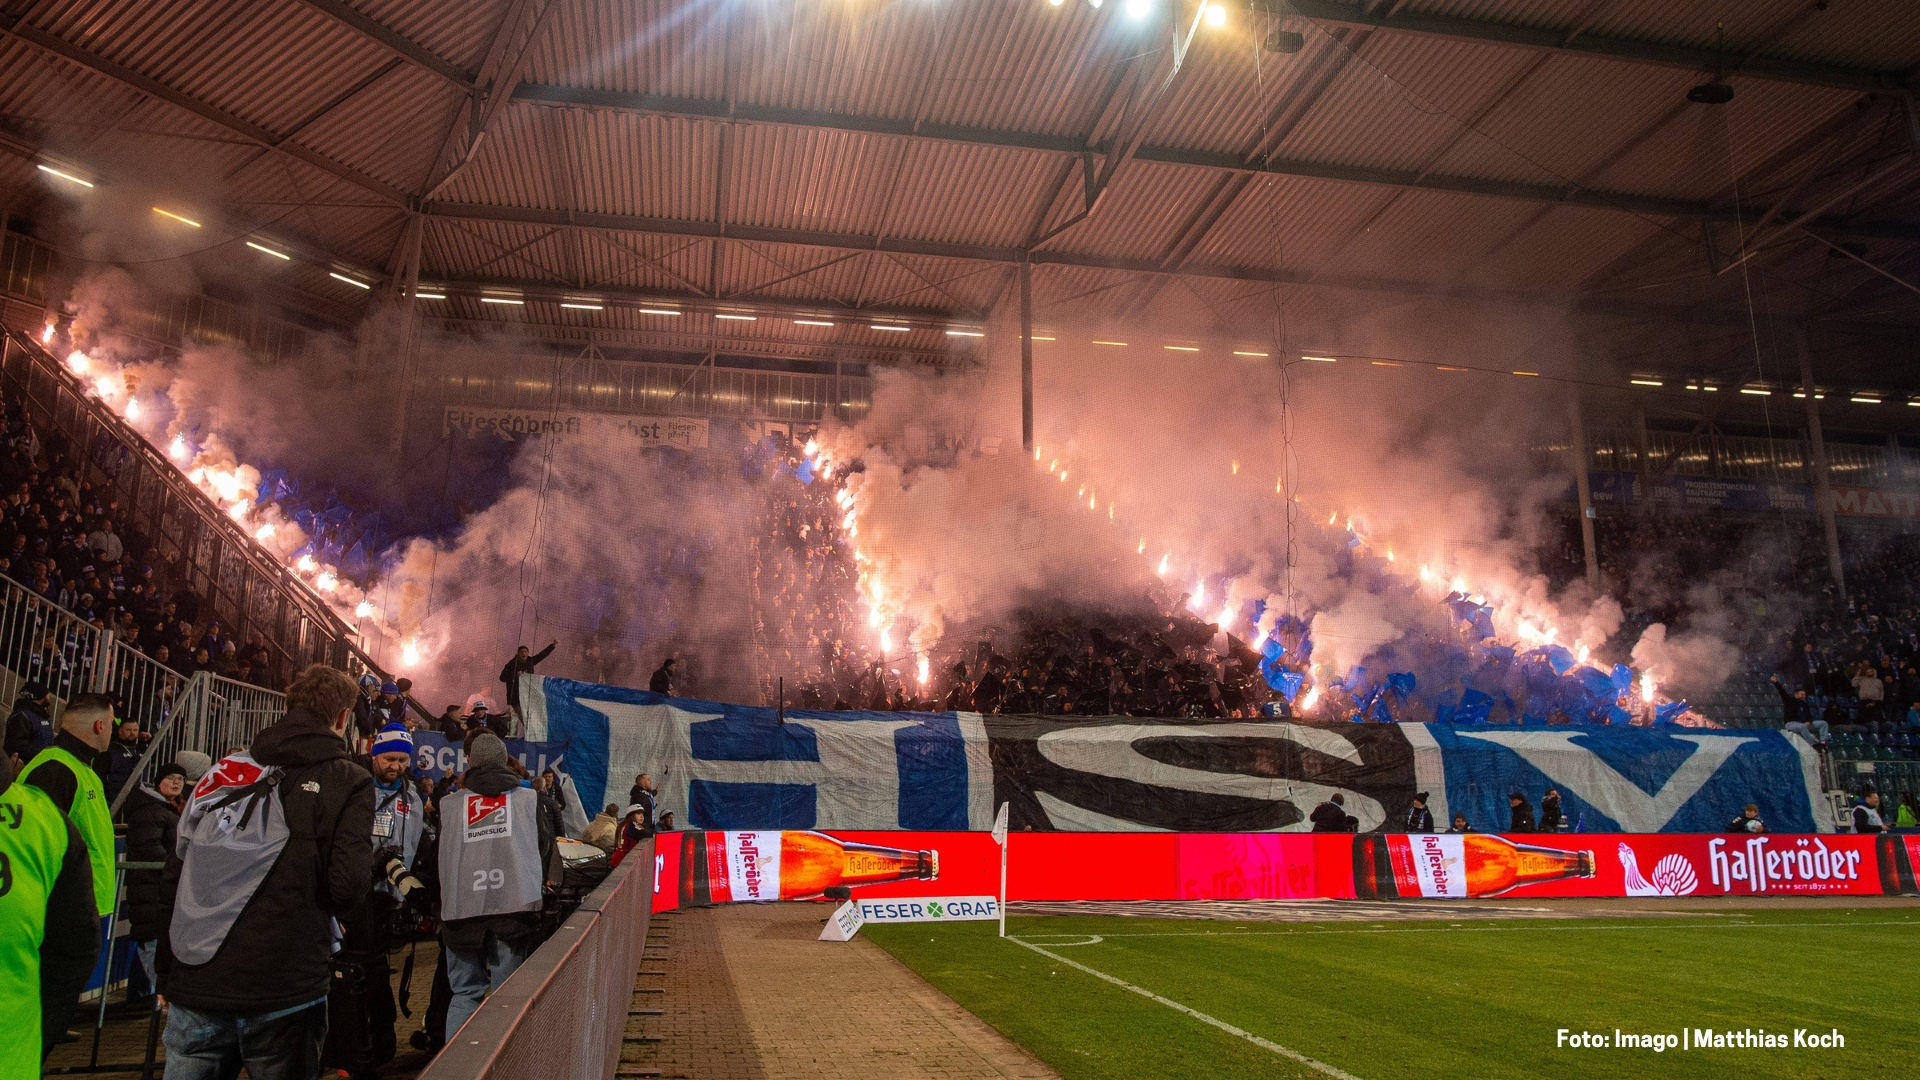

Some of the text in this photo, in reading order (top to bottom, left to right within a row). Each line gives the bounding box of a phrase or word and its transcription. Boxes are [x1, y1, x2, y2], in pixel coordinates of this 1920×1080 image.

[573, 696, 1762, 833] HSV
[494, 807, 506, 823] 2
[467, 826, 508, 839] BUNDESLIGA
[472, 868, 505, 892] 29
[1808, 882, 1827, 891] 1872
[861, 901, 997, 919] FESER GRAF
